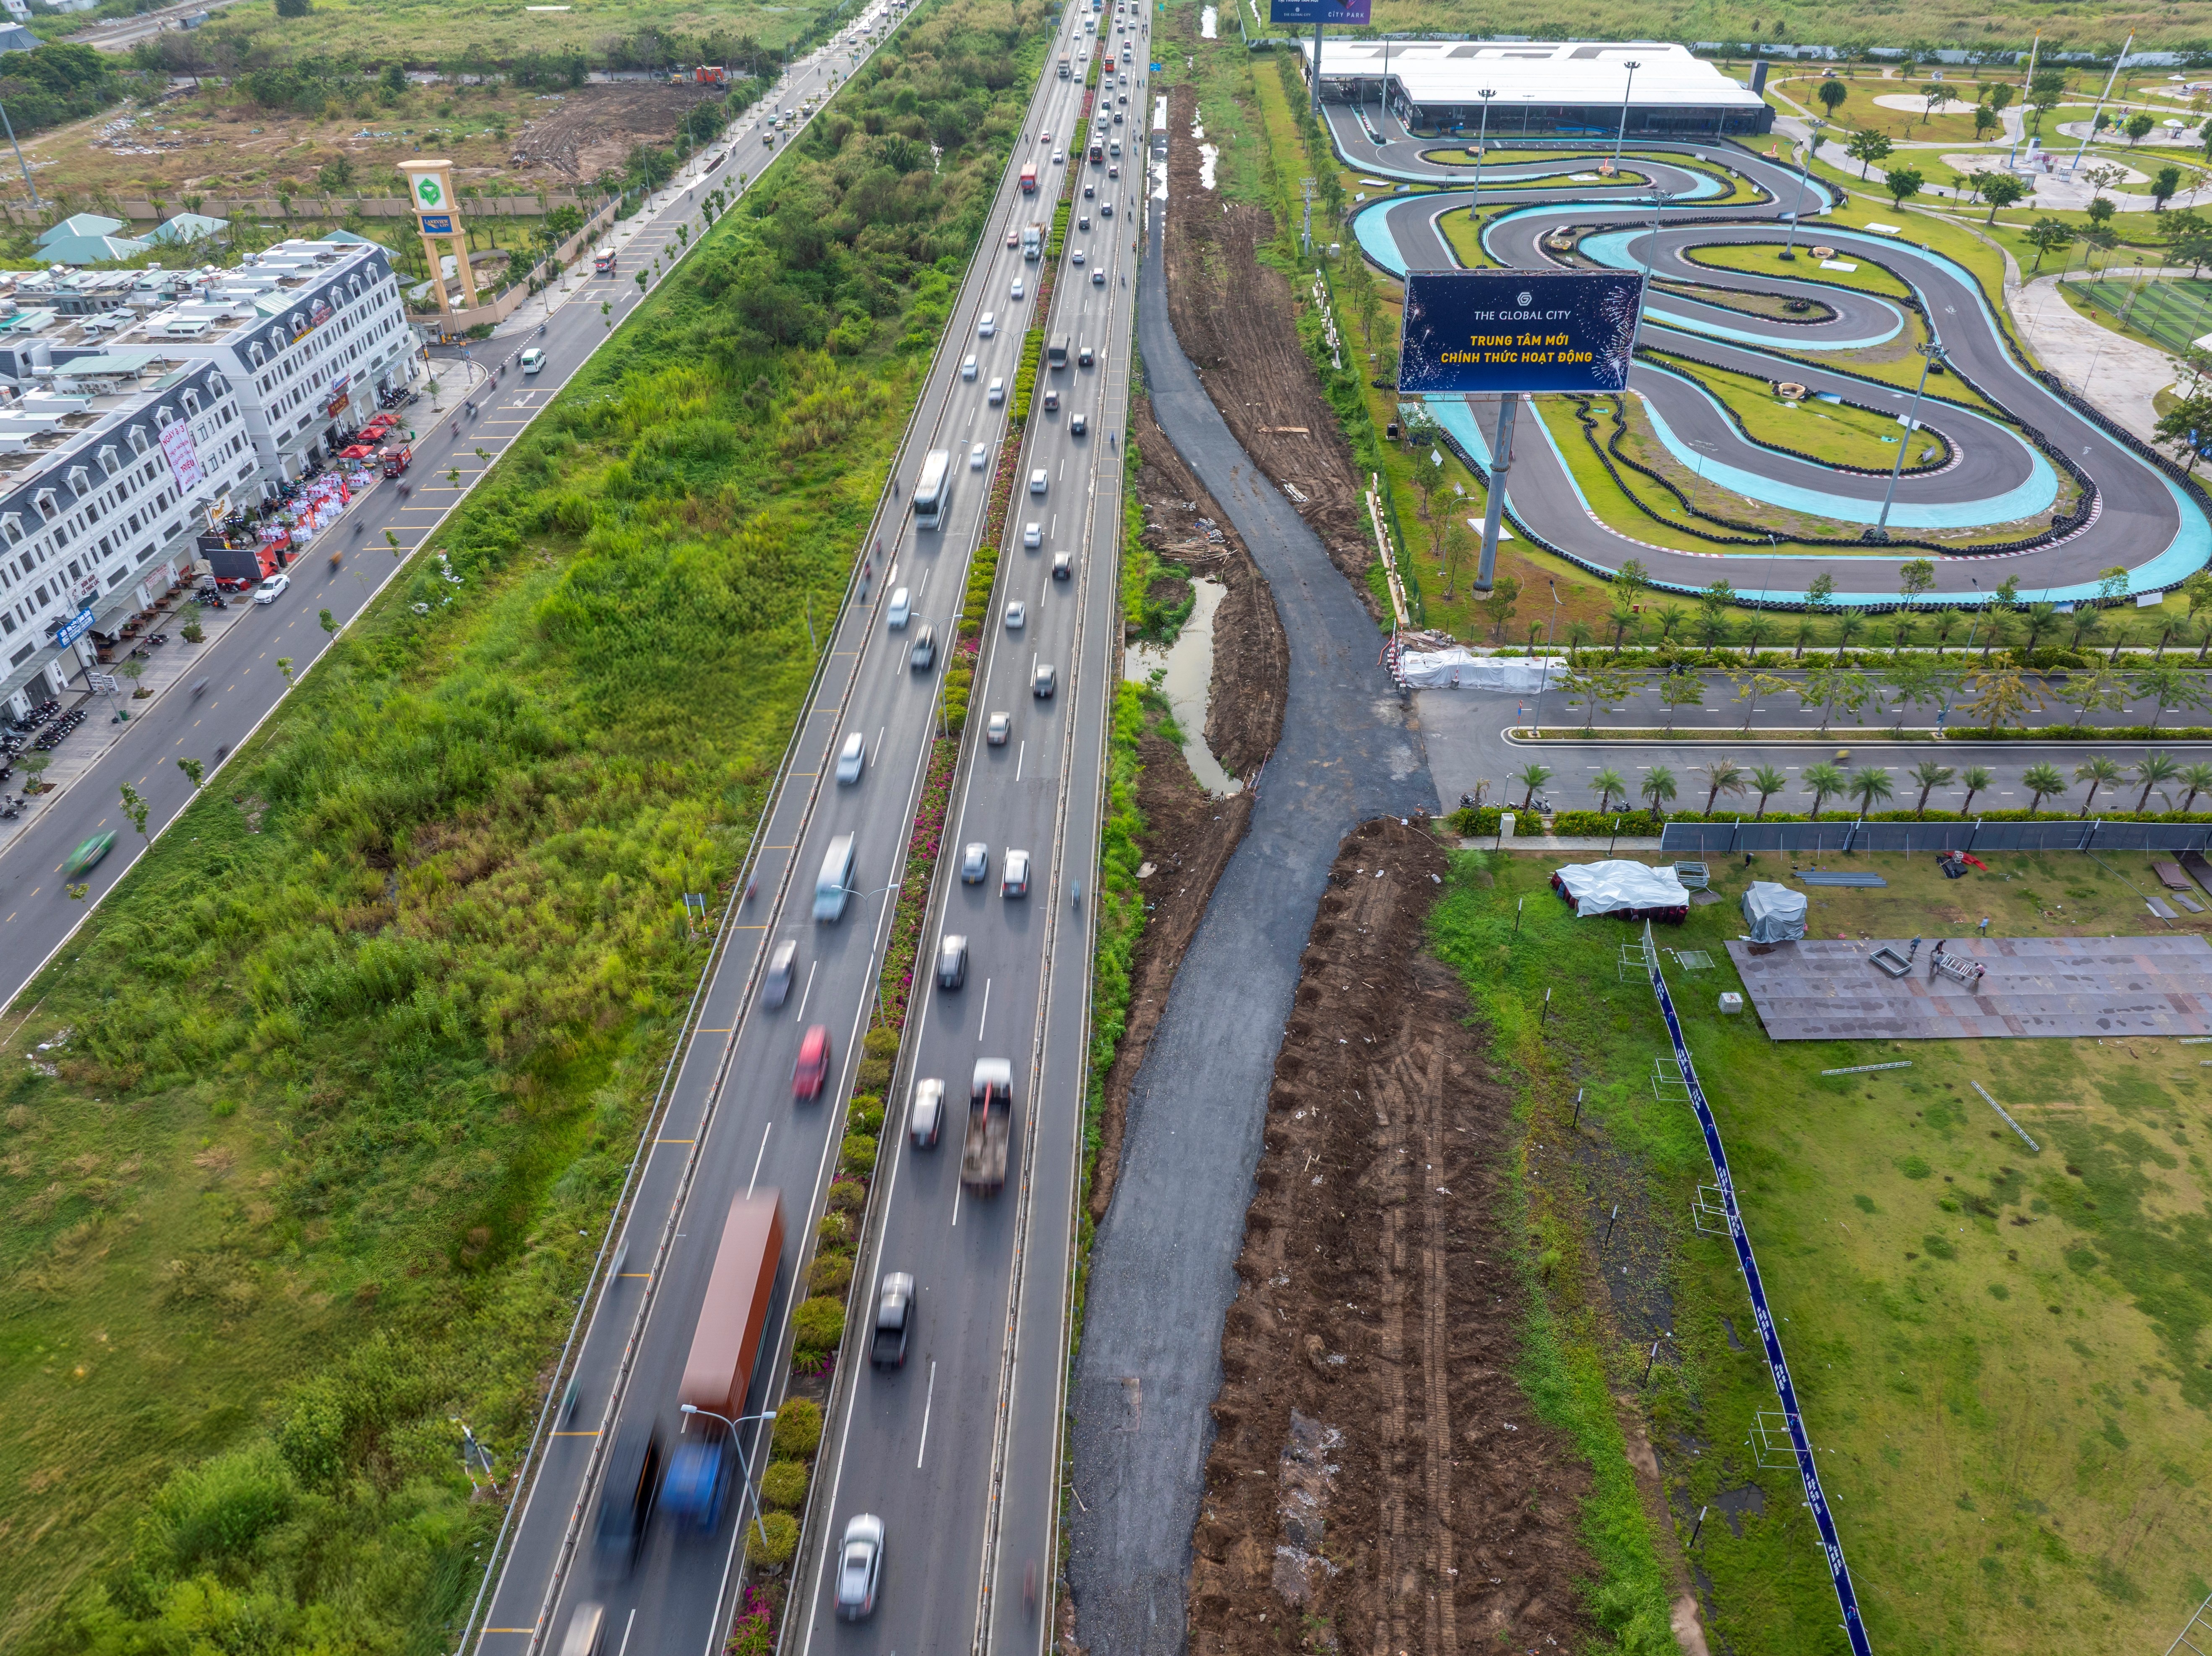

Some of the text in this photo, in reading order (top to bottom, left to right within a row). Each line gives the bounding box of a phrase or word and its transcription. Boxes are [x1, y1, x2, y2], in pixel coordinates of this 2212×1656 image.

[1474, 310, 1571, 320] THE GLOBAL CITY
[1470, 332, 1569, 346] TRUNG TÂM MỚI
[1441, 349, 1593, 365] CHÍNH THỨC HOẠT ĐỘNG
[162, 430, 175, 446] NGÀY
[180, 459, 195, 474] TRIỆU
